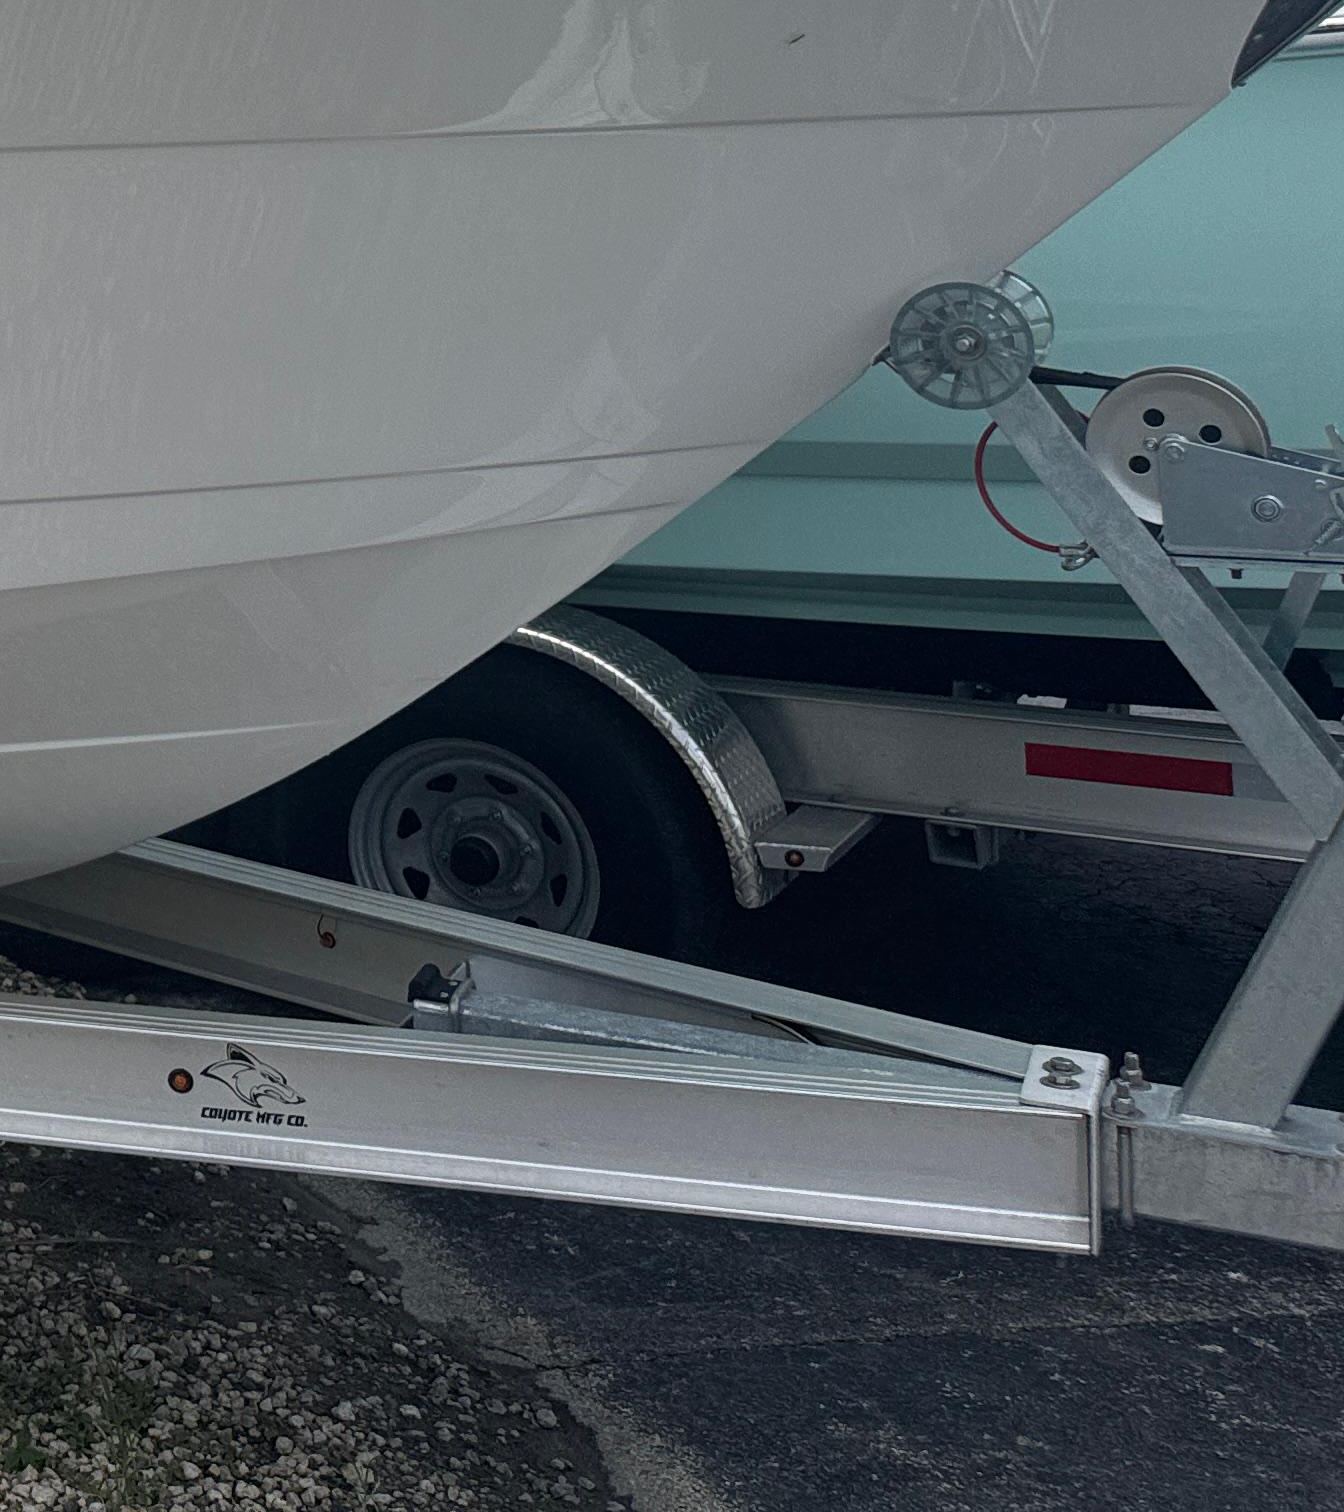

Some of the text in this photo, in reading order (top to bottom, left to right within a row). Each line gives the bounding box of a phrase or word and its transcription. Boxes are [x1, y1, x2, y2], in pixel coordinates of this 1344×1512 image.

[200, 1107, 308, 1128] COYOTE MFG CO.
